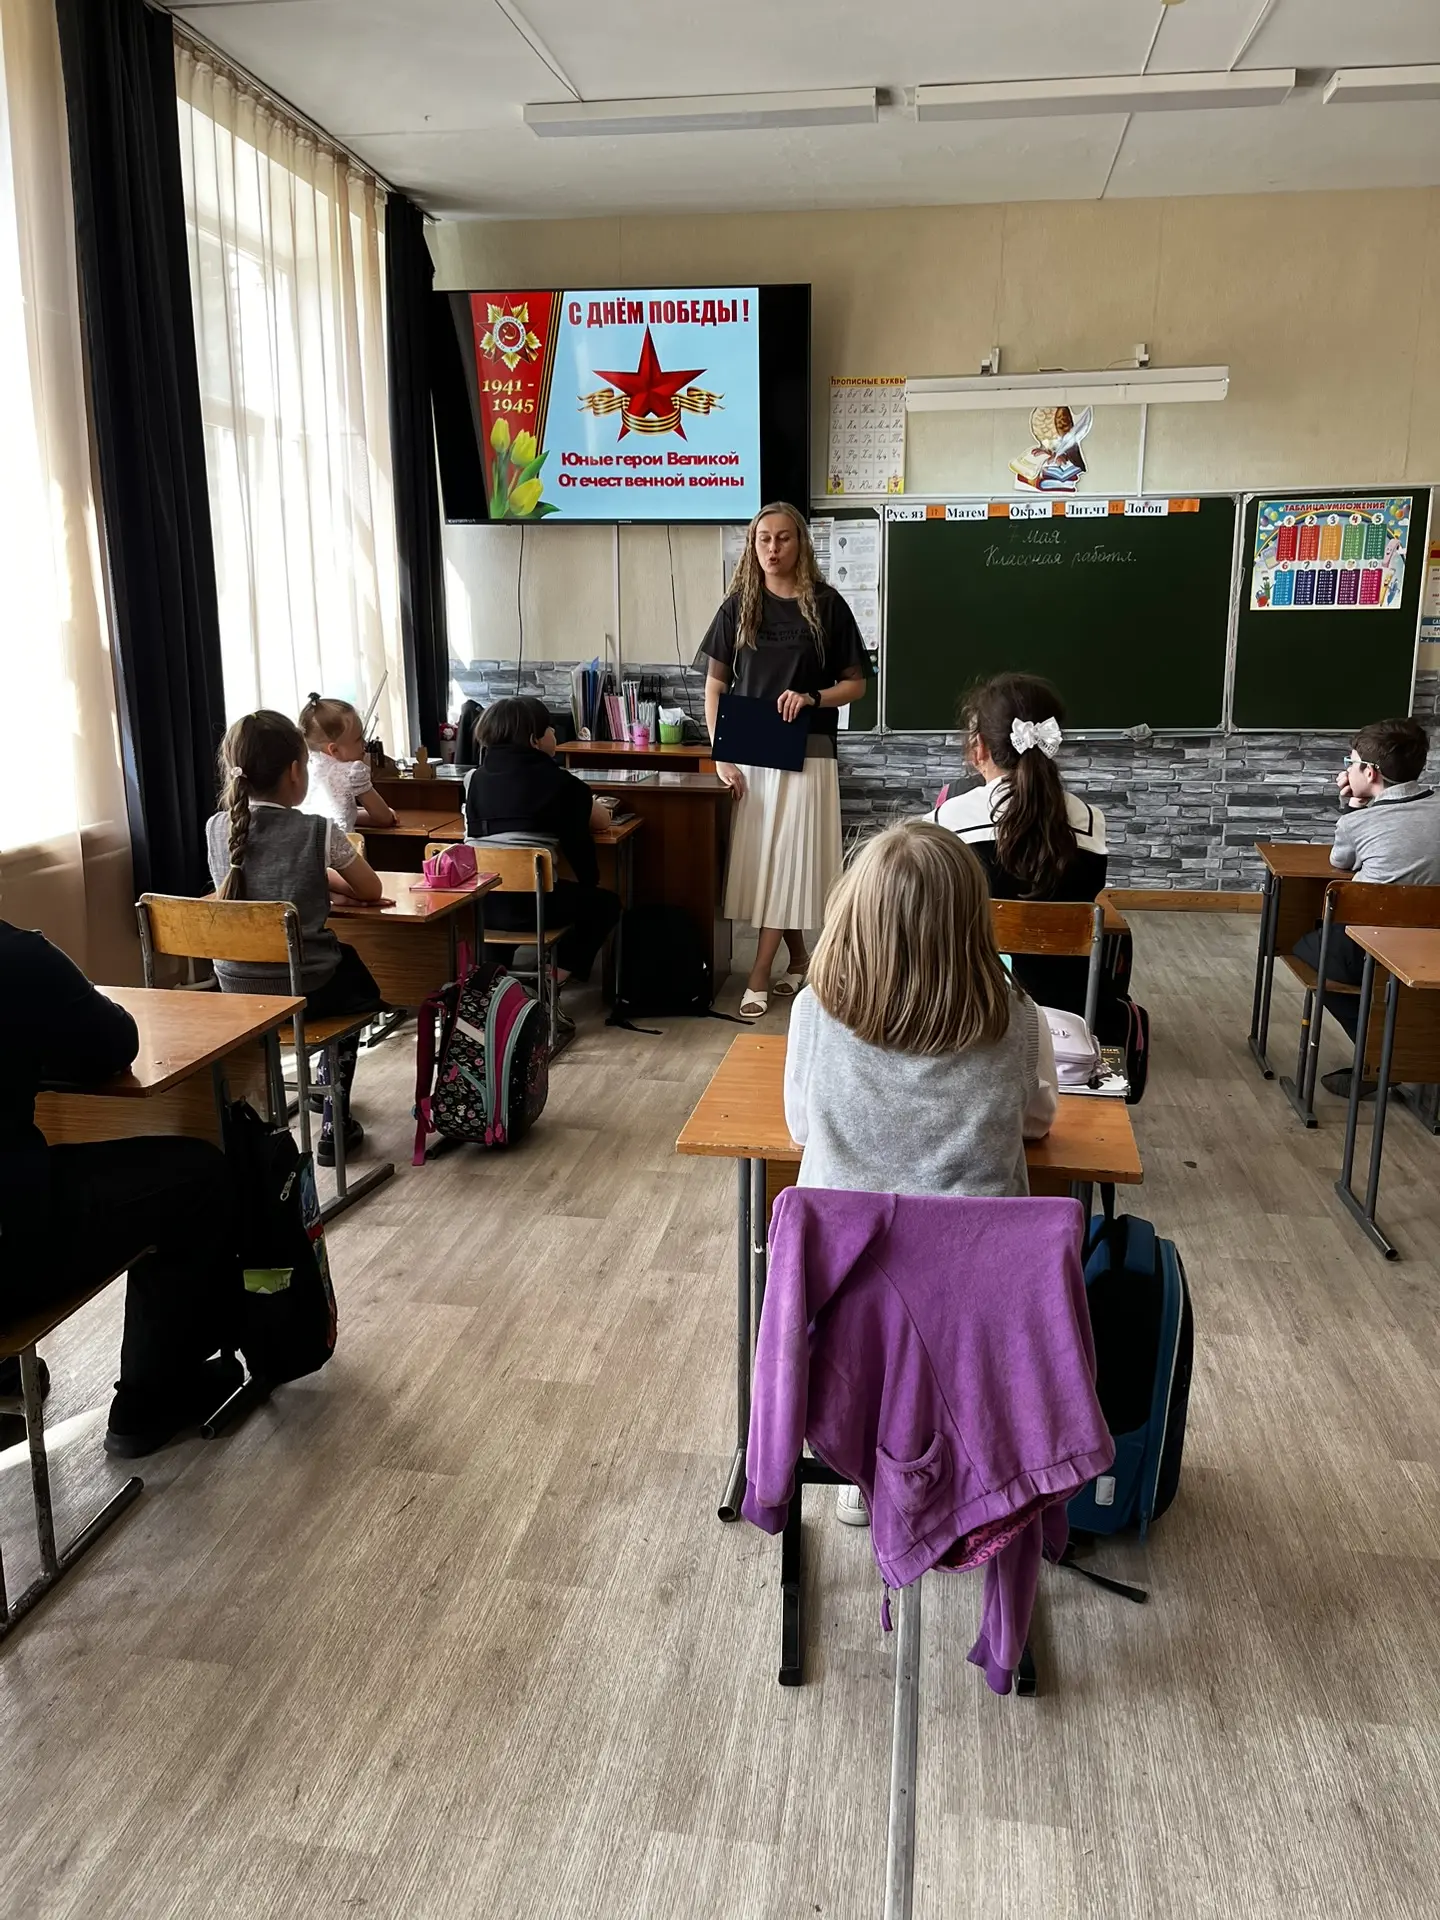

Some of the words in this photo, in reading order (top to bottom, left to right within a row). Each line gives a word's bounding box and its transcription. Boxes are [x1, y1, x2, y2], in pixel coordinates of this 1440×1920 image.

[568, 302, 582, 325] С
[587, 297, 644, 328] ДНЁМ
[650, 299, 738, 327] ПОБЕДЫ
[880, 377, 906, 385] БУКВЫ
[492, 398, 535, 414] 1945
[561, 452, 613, 466] Юные
[616, 454, 663, 468] герои
[667, 451, 739, 466] Великой
[558, 473, 685, 487] Отечественной
[689, 473, 744, 487] войны
[886, 505, 908, 520] Рус.
[911, 508, 924, 518] яз
[947, 505, 986, 518] Матем
[1010, 506, 1047, 520] Окр.м
[1066, 504, 1107, 515] Лит.чт
[1125, 503, 1162, 514] Логоп
[1285, 503, 1325, 512] ТАБЛИЦА
[1327, 502, 1386, 511] УМНОЖЕНИЯ
[1308, 516, 1314, 525] 2
[1330, 516, 1336, 524] 3
[1352, 515, 1358, 524] 4
[1375, 514, 1381, 523] 5
[984, 544, 1064, 567] Классная
[1282, 561, 1288, 569] 6
[1304, 561, 1310, 569] 7
[1325, 560, 1332, 569] 8
[1368, 561, 1378, 569] 10
